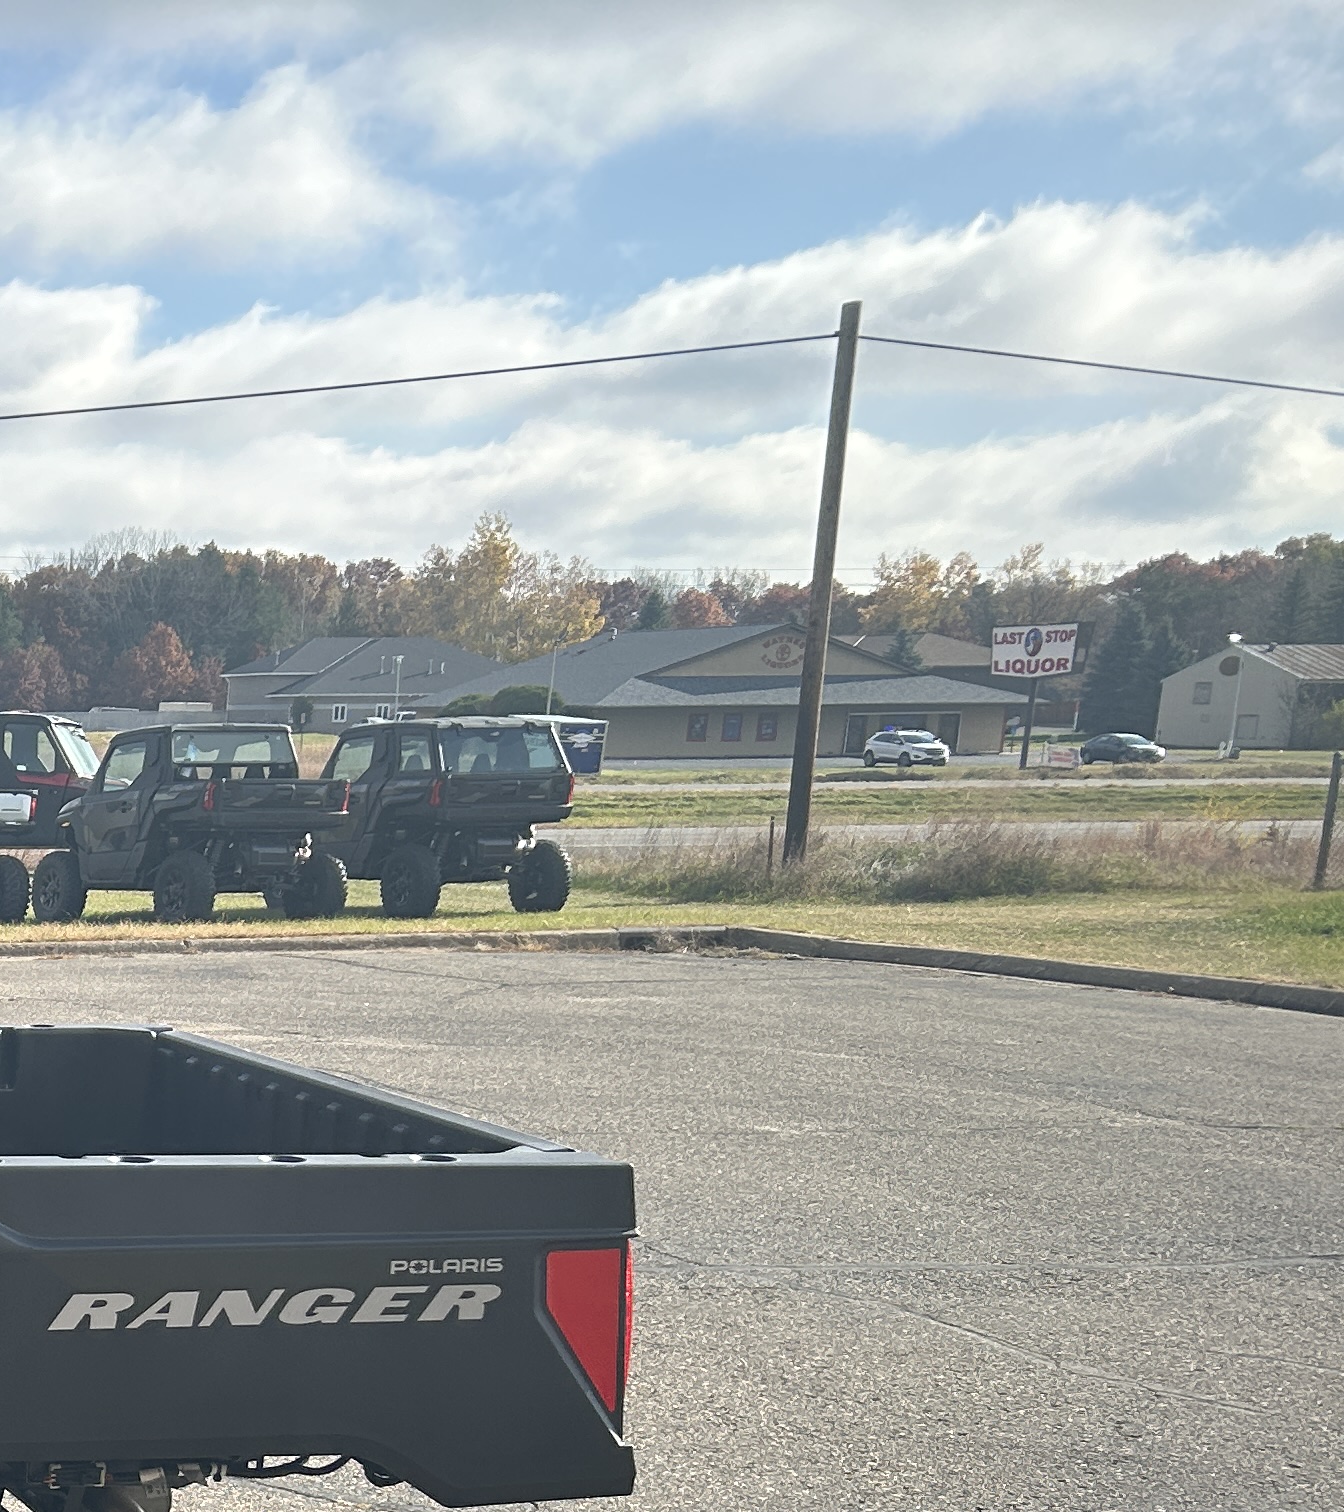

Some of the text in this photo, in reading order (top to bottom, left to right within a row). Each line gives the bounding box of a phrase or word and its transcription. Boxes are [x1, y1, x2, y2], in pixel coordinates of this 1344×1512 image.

[994, 629, 1077, 645] LAST STOP
[993, 658, 1070, 675] LIQUOR
[390, 1257, 504, 1275] POLARIS
[47, 1283, 503, 1332] RANGER
